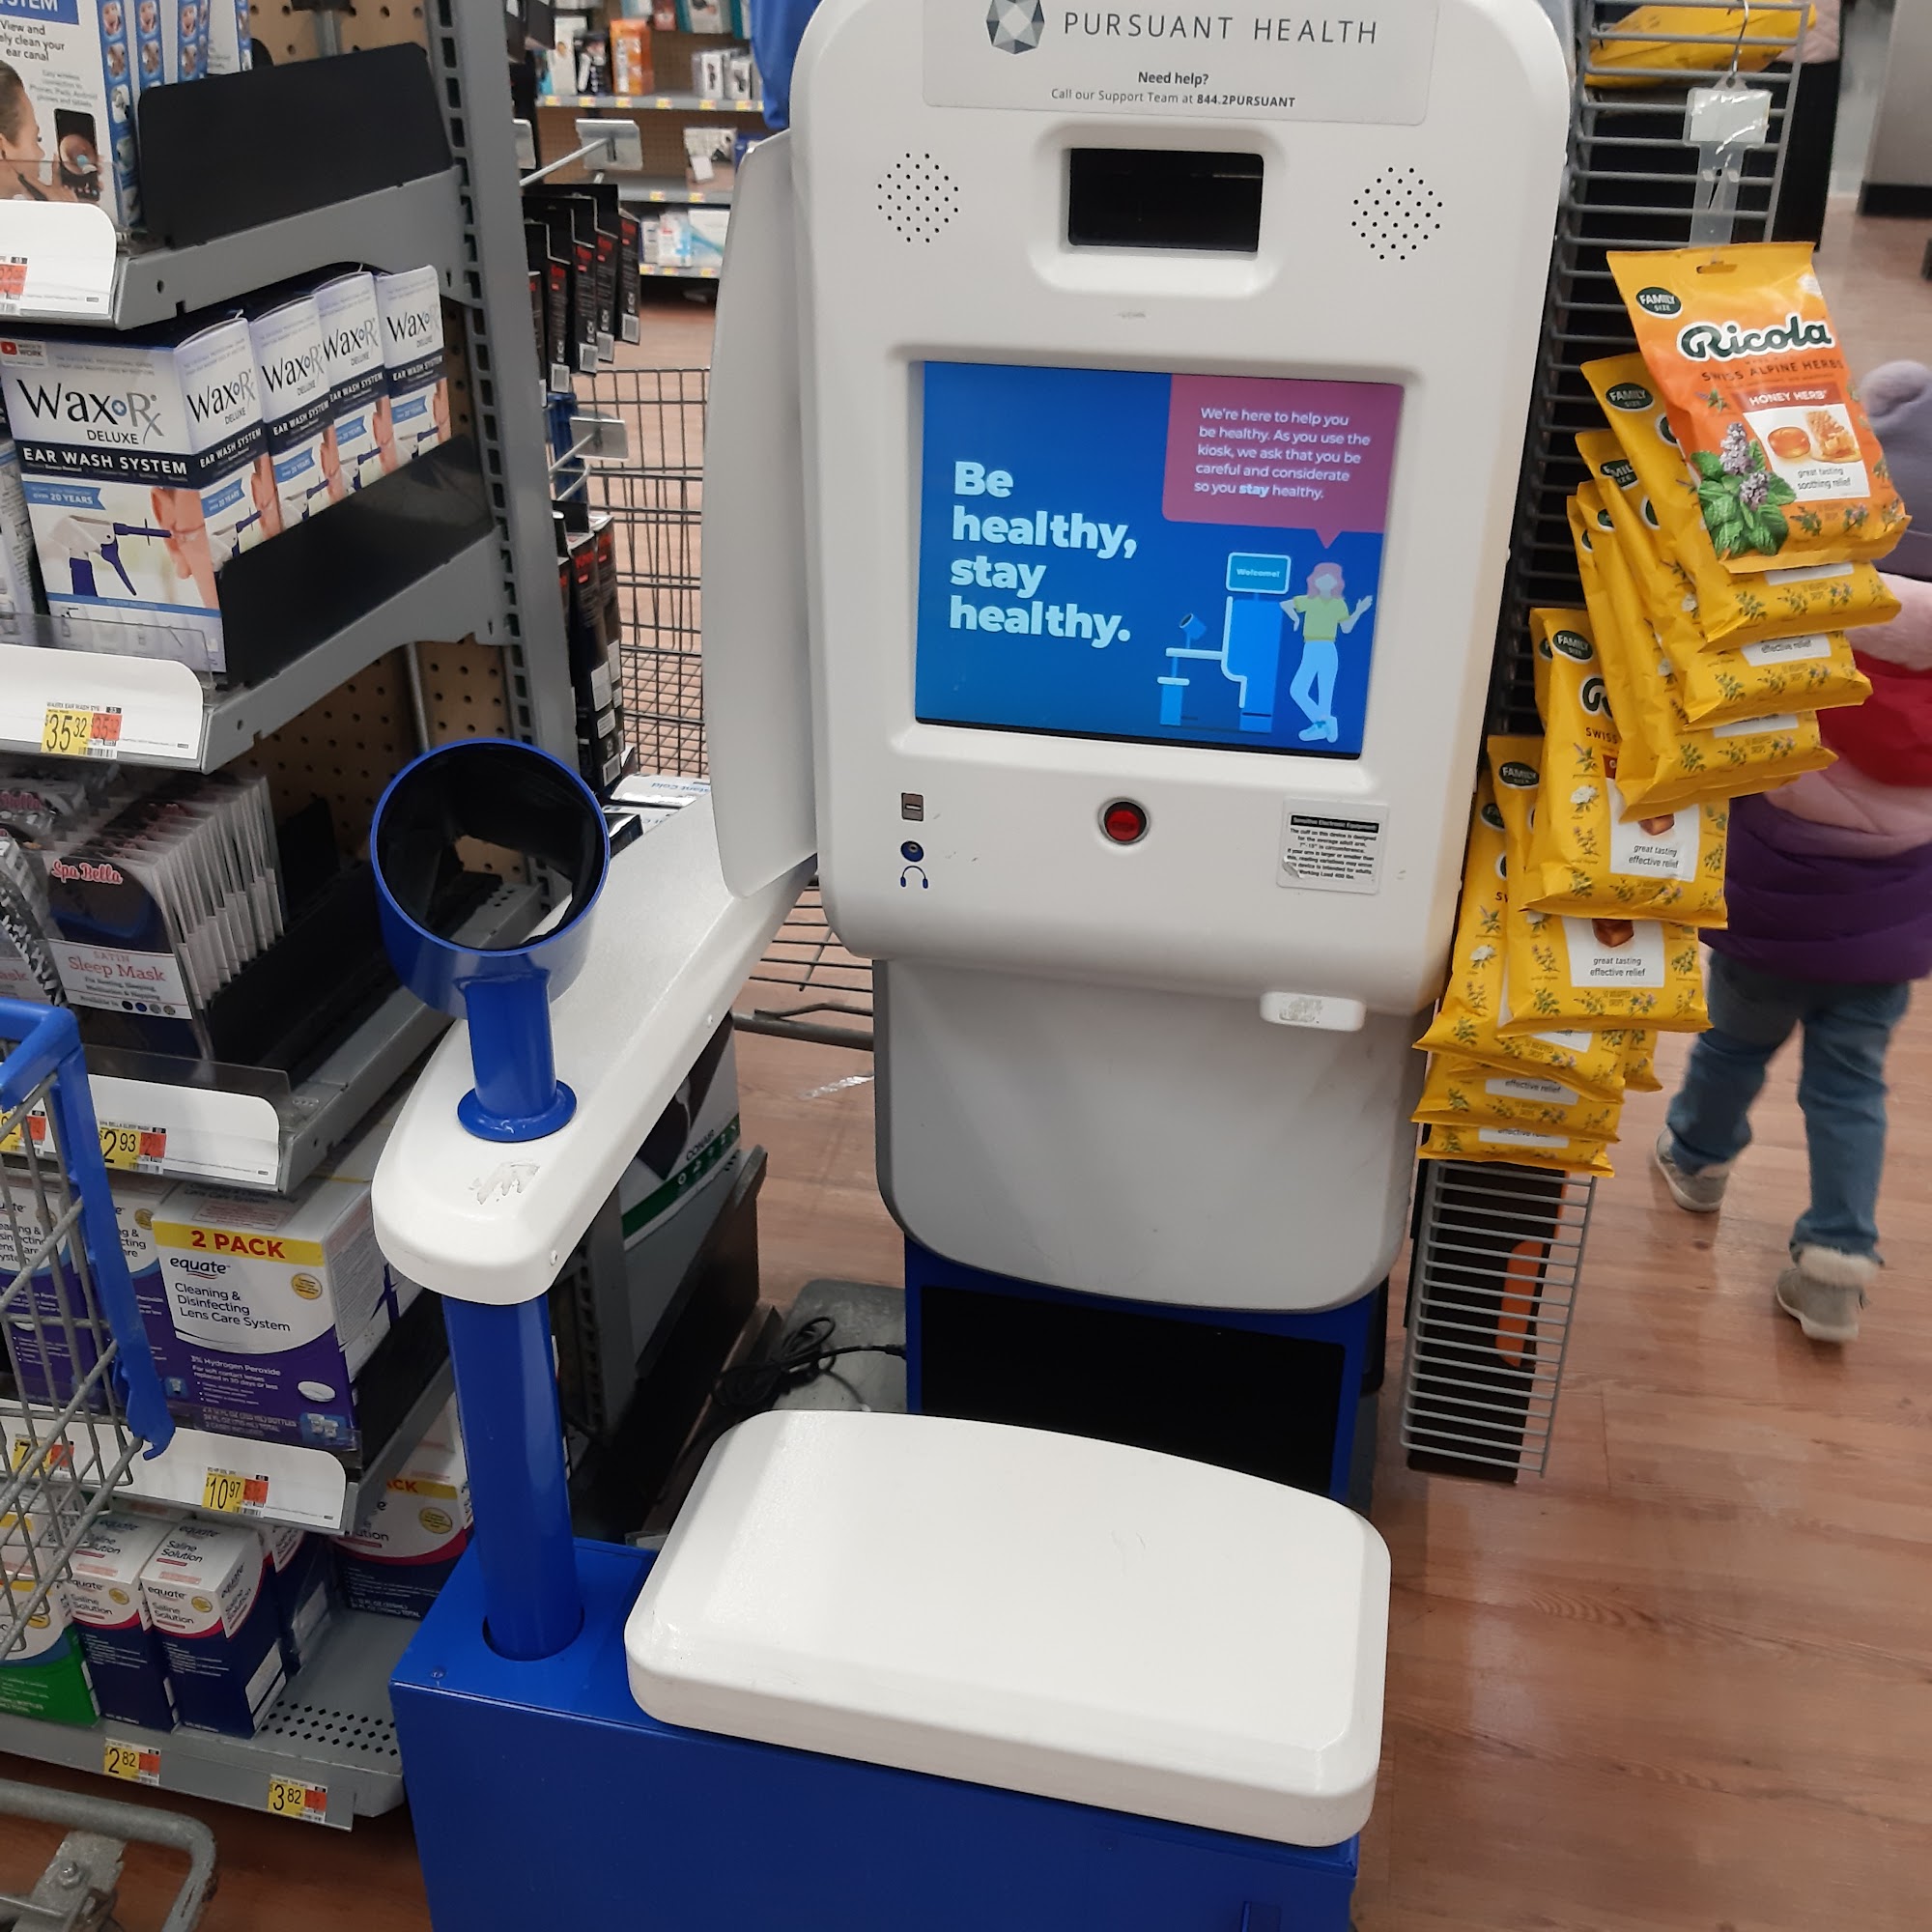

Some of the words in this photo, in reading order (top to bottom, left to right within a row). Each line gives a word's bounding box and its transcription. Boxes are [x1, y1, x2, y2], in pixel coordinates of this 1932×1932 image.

[1, 20, 25, 31] View
[28, 25, 45, 35] and
[1064, 12, 1234, 41] PURSUANT
[1255, 18, 1378, 44] HEALTH
[15, 36, 40, 46] clean
[43, 41, 65, 51] your
[6, 48, 21, 57] ear
[24, 50, 49, 61] canal
[1138, 71, 1172, 84] Need
[1175, 72, 1209, 88] help?
[1051, 89, 1072, 99] Call
[1075, 92, 1094, 100] our
[1098, 90, 1144, 104] Support
[1148, 92, 1179, 103] Team
[1181, 94, 1194, 104] at
[1197, 94, 1295, 108] 844.2PURSUANT
[1639, 294, 1676, 305] FAMILY
[1681, 316, 1832, 358] Ricola
[392, 369, 406, 382] EAR
[1702, 371, 1744, 382] SWISS
[1750, 362, 1799, 377] ALPINE
[342, 382, 360, 396] WASH
[1609, 390, 1646, 401] FAMILY
[1749, 391, 1791, 406] HONEY
[273, 422, 288, 436] EAR
[289, 412, 308, 429] WASH
[308, 400, 329, 419] SYSTEM
[1201, 408, 1239, 421] We're
[1241, 410, 1271, 422] here
[1274, 412, 1289, 423] to
[1291, 412, 1321, 427] help
[1322, 414, 1349, 428] you
[87, 430, 139, 445] DELUXE
[1199, 426, 1216, 438] be
[1219, 427, 1270, 443] healthy.
[1273, 430, 1290, 441] As
[1293, 432, 1317, 444] you
[1321, 435, 1345, 444] use
[1347, 433, 1371, 446] the
[200, 454, 215, 469] EAR
[216, 443, 237, 460] WASH
[238, 428, 262, 448] SYSTEM
[1197, 443, 1235, 458] kiosk,
[1236, 447, 1257, 458] we
[1260, 448, 1283, 460] ask
[1285, 448, 1313, 462] that
[1315, 451, 1340, 465] you
[1344, 451, 1361, 464] be
[23, 448, 58, 463] EAR
[61, 451, 114, 469] WASH
[120, 457, 187, 475] SYSTEM
[953, 461, 1014, 498] Be
[1195, 463, 1240, 475] careful
[1243, 466, 1269, 477] and
[1272, 468, 1350, 482] considerate
[50, 493, 62, 501] 20
[63, 494, 93, 504] YEARS
[1194, 482, 1208, 492] so
[1211, 483, 1236, 496] you
[1238, 483, 1270, 497] stay
[1272, 485, 1324, 500] healthy.
[952, 505, 1138, 559] healthy,
[949, 554, 1046, 599] stay
[1236, 568, 1281, 579] Welcome!
[949, 594, 1131, 649] healthy.
[1556, 634, 1589, 652] FAMILY
[1585, 727, 1619, 744] SWISS
[1502, 767, 1537, 779] FAMILY
[1654, 847, 1677, 857] tasting
[1629, 856, 1661, 866] effective
[1662, 860, 1679, 868] relief
[51, 860, 80, 883] Spa
[79, 863, 123, 885] Bella
[93, 951, 129, 962] SATIN
[1615, 957, 1641, 966] tasting
[68, 955, 113, 978] Sleep
[117, 964, 166, 981] Mask
[1505, 1079, 1539, 1091] effective
[191, 1231, 207, 1248] 2
[213, 1233, 286, 1259] PACK
[170, 1258, 227, 1274] equate
[175, 1282, 229, 1301] Cleaning
[232, 1291, 242, 1301] &
[177, 1294, 250, 1316] Disinfecting
[180, 1307, 209, 1321] Lens
[211, 1313, 241, 1325] Care
[243, 1318, 291, 1332] System
[204, 1357, 243, 1371] Hydrogen
[244, 1365, 281, 1376] Peroxide
[167, 1540, 197, 1552] Saline
[161, 1548, 203, 1563] Solution
[148, 1586, 186, 1599] equate
[152, 1602, 181, 1614] Saline
[154, 1610, 194, 1625] Solution
